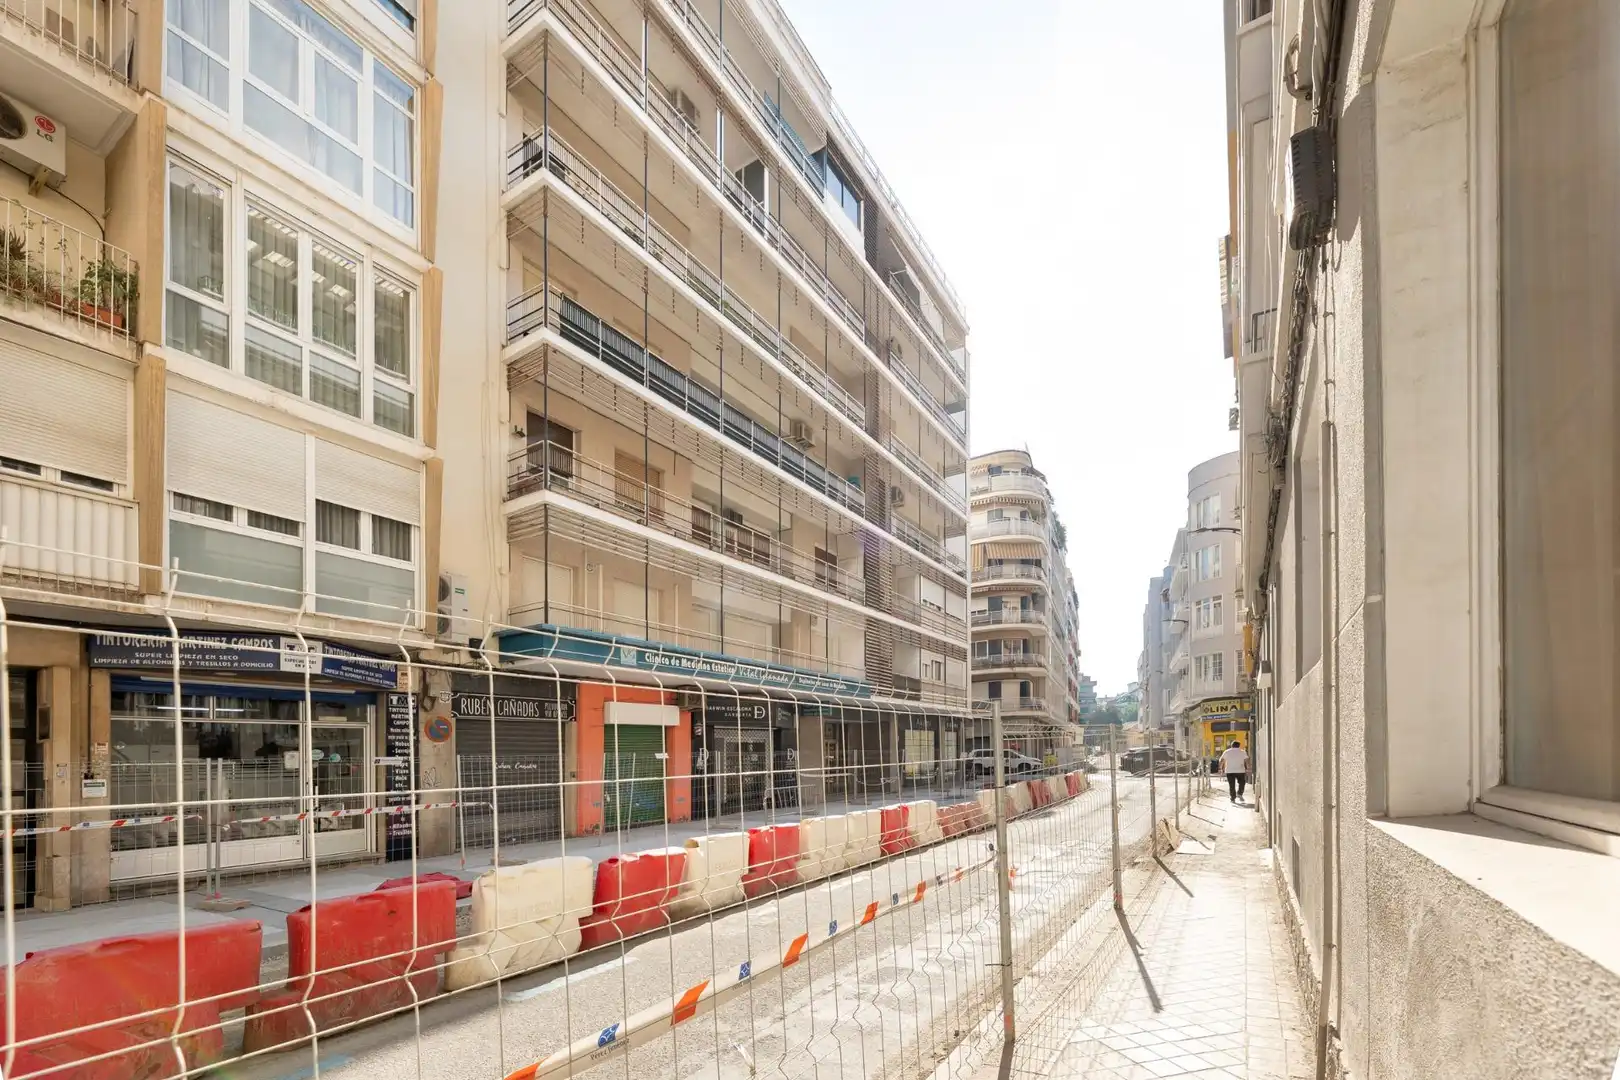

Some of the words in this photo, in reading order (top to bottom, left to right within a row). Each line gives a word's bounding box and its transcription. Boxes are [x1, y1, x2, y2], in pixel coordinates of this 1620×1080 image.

[231, 637, 274, 650] CAMPOS
[165, 653, 202, 661] LIPIEZA
[671, 656, 680, 666] de
[498, 699, 540, 717] CAÑADAS
